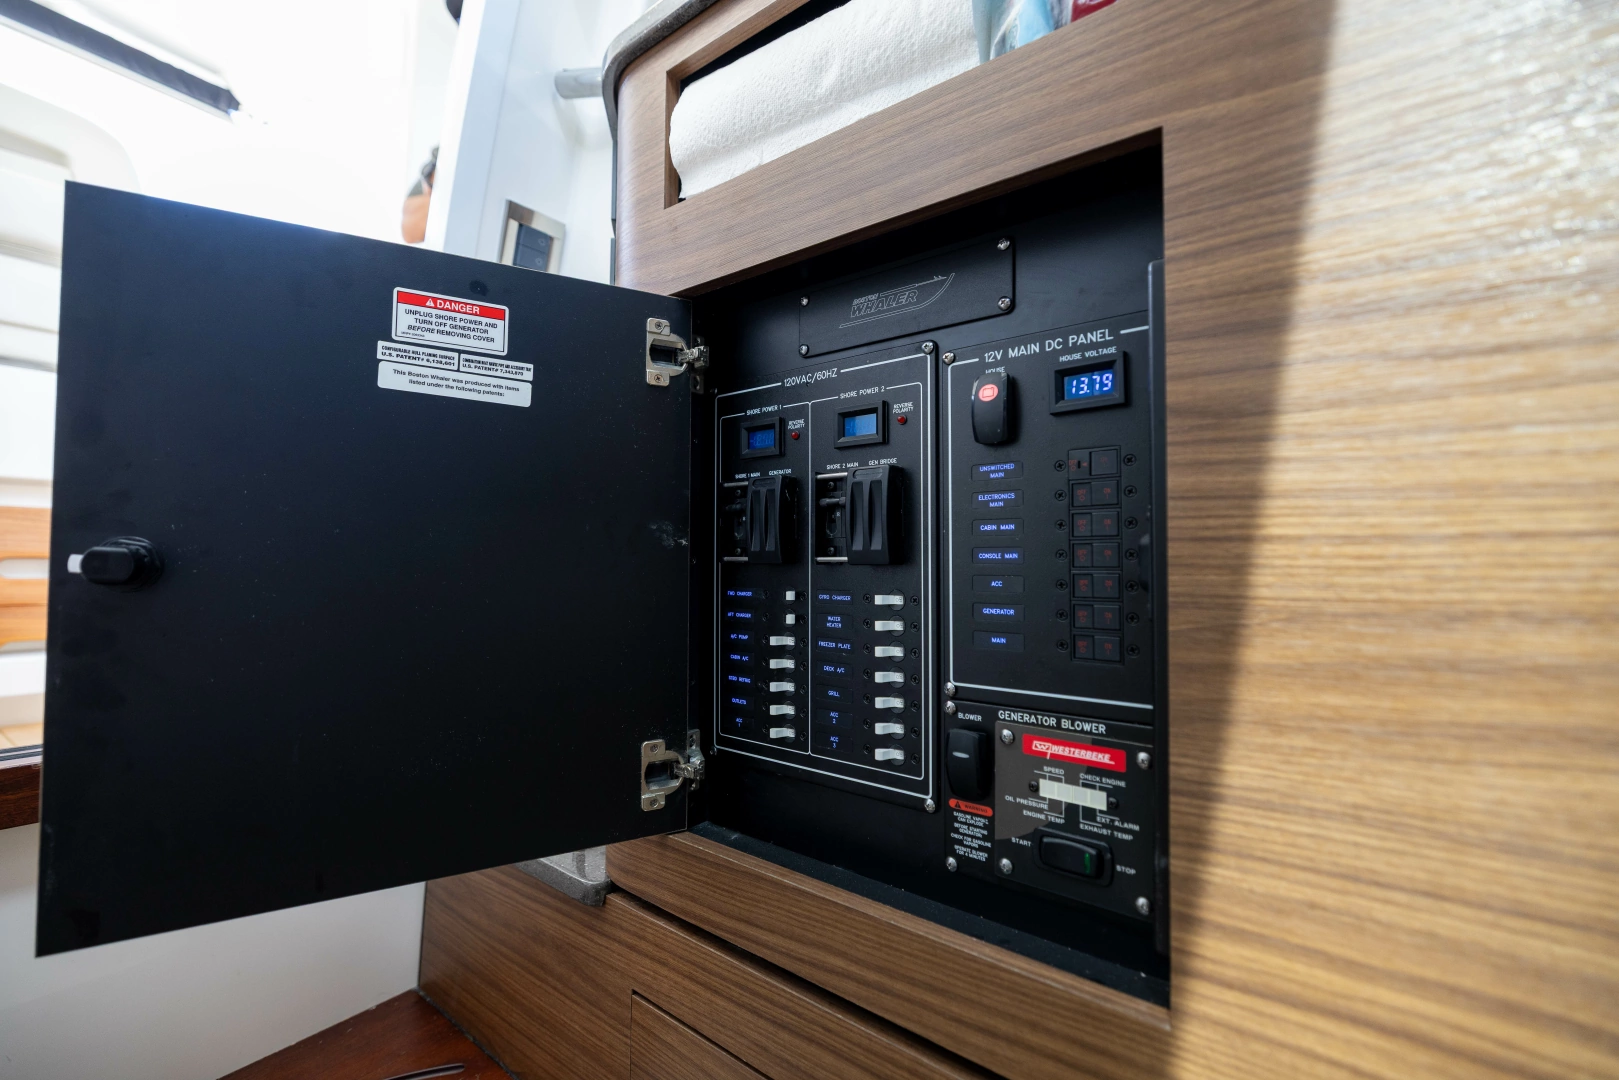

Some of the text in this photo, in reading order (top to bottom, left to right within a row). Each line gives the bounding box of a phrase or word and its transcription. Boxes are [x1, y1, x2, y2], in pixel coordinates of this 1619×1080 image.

[437, 300, 480, 314] DANGER
[851, 290, 918, 317] WHALER
[405, 308, 433, 318] UNPLUG
[435, 314, 457, 322] SHORE
[459, 318, 483, 326] POWER
[408, 325, 494, 343] BEFORE REMOVING COVER
[449, 323, 488, 334] GENERATOR
[984, 329, 1114, 363] 12V MAIN DC PANEL
[1059, 346, 1117, 362] HOUSE VOLTAGE
[784, 368, 837, 387] 120VAC/60HZ
[1072, 373, 1113, 394] 13.79
[456, 386, 481, 394] following
[840, 391, 857, 399] SHORE
[860, 386, 879, 395] POWER
[979, 463, 1014, 472] UNSWITCHED
[958, 712, 982, 722] BLOWER
[998, 710, 1106, 734] GENERATOR BLOWER
[1051, 744, 1111, 762] WESTERBEKE
[1044, 766, 1064, 775] SPEED
[1080, 773, 1126, 787] CHECK ENGINE
[965, 804, 988, 813] WARNING
[1016, 798, 1048, 810] PRESSURE
[1023, 810, 1065, 824] ENGINE TEMP
[1097, 816, 1140, 831] EXT. ALARM
[1080, 824, 1133, 840] EXHAUST TEMP
[1012, 837, 1031, 847] START
[1116, 865, 1136, 875] STOP
